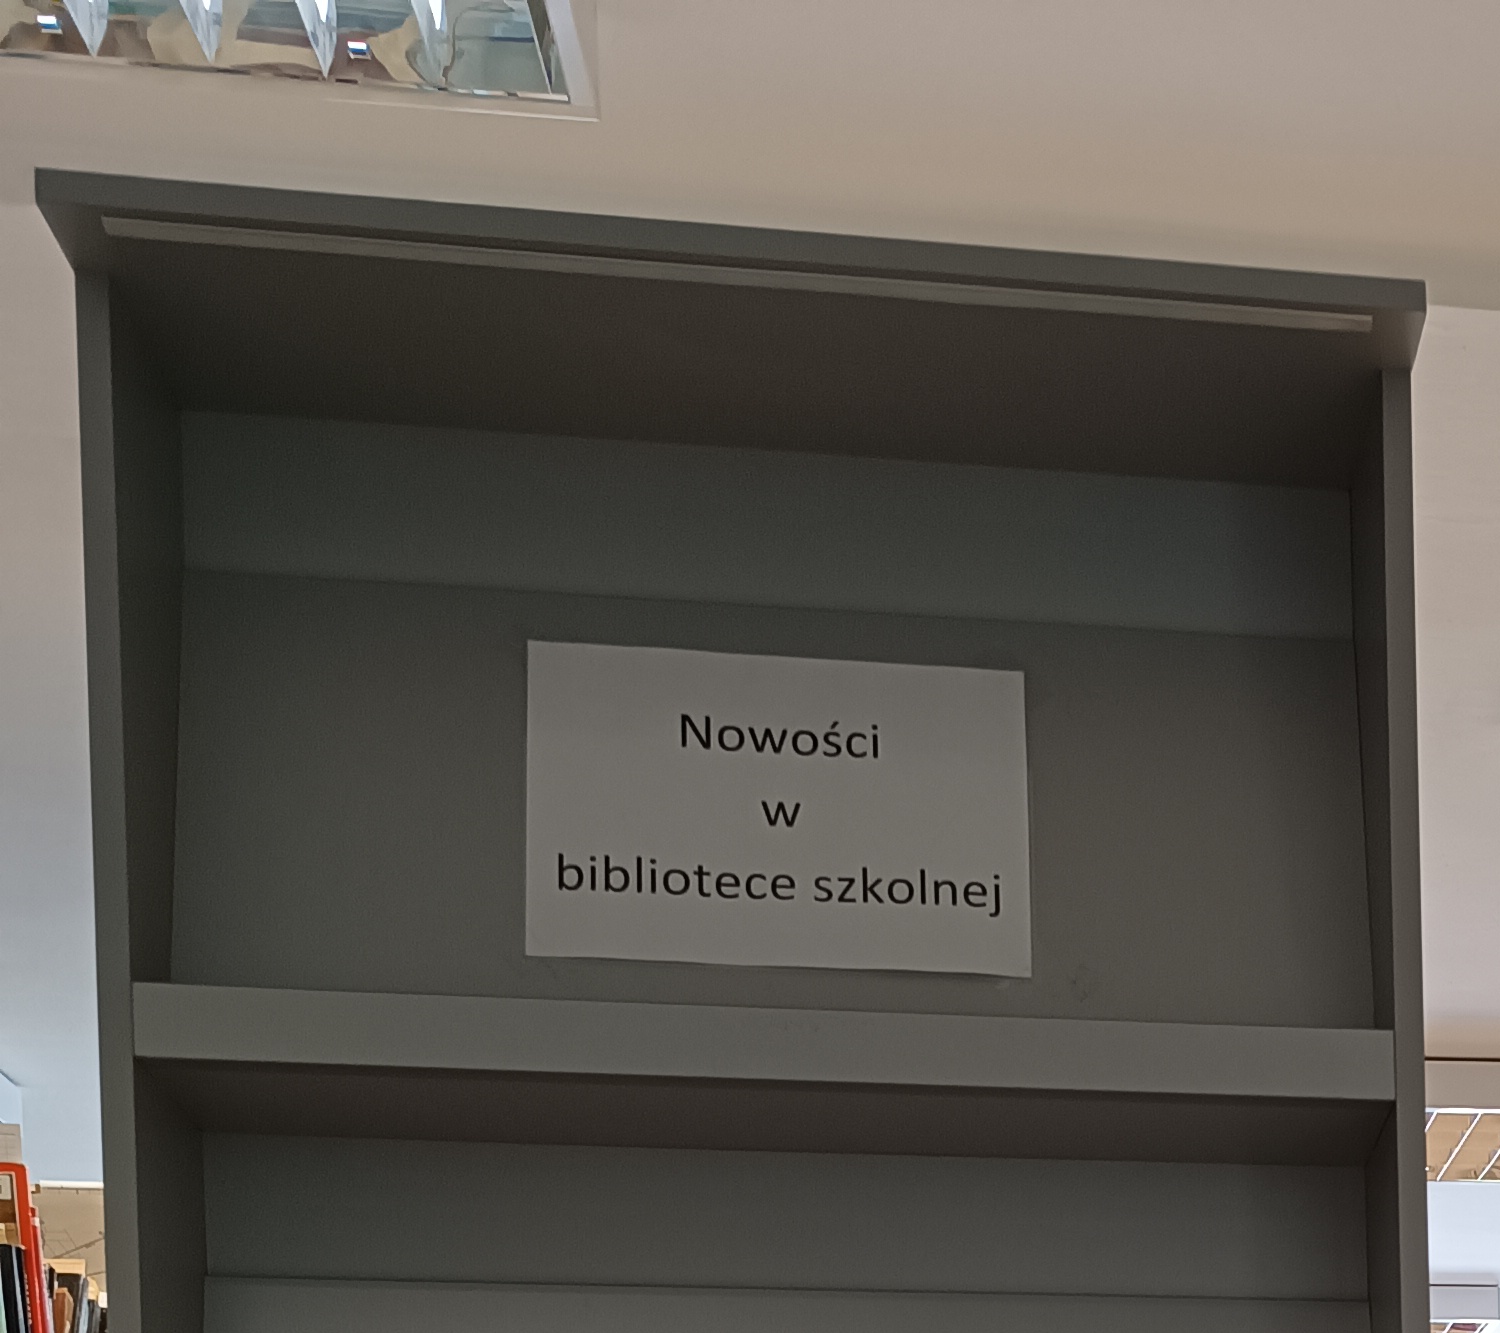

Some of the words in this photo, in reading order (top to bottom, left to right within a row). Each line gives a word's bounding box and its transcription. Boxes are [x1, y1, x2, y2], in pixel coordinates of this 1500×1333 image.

[680, 713, 880, 759] Nowości
[761, 801, 801, 827] w
[557, 852, 797, 900] bibliotece
[812, 866, 1001, 918] szkolnej
